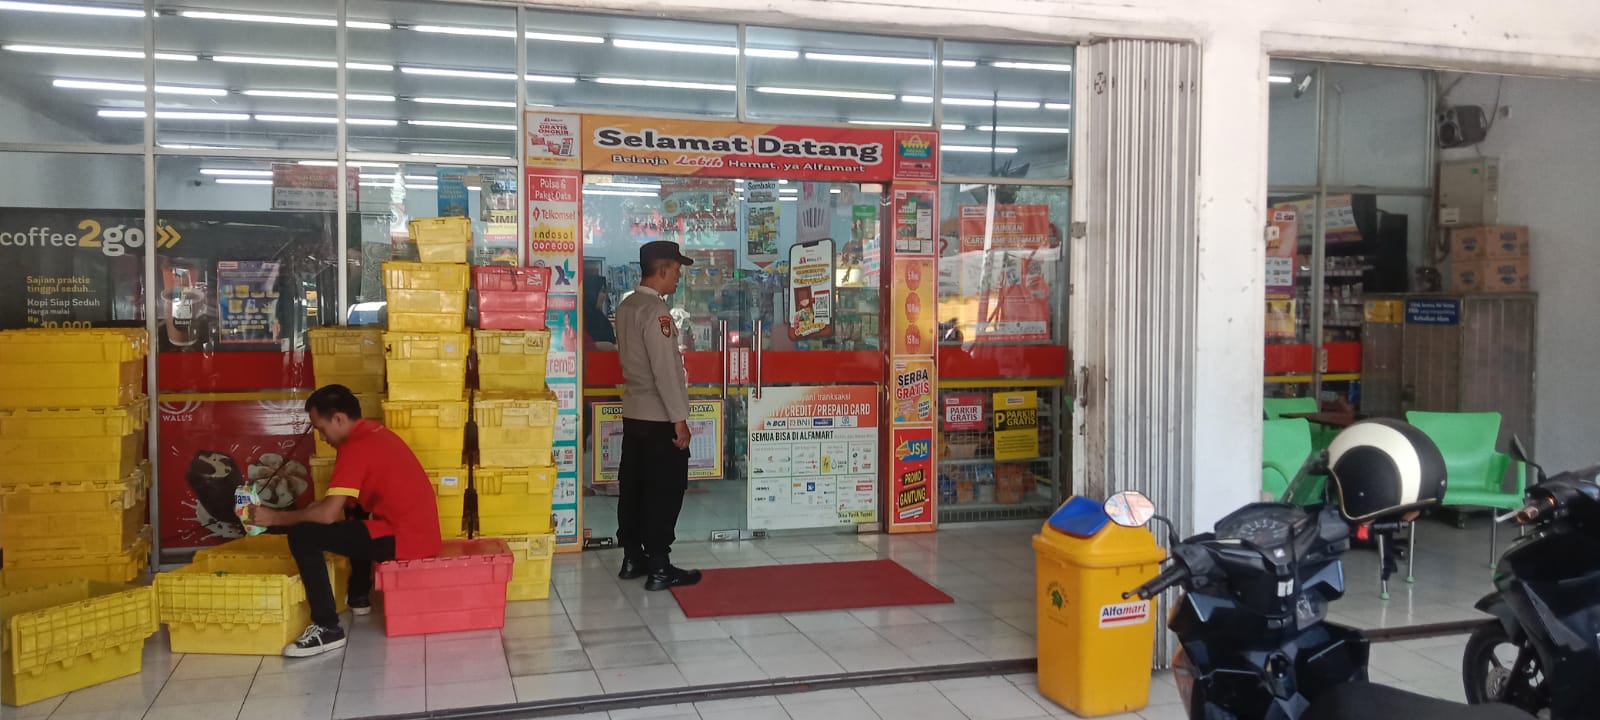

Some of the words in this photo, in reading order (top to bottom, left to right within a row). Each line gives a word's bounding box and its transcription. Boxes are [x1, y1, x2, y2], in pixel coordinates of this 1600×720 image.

[597, 129, 748, 153] Selamat
[757, 137, 878, 163] Datang
[612, 154, 669, 166] Belanja
[674, 154, 724, 168] Lebih
[728, 159, 780, 170] Hemat,
[783, 163, 799, 172] ya
[803, 162, 865, 173] Alfamart
[540, 178, 559, 189] Pulsa
[535, 190, 554, 200] Paket
[541, 209, 576, 220] Telkomsel
[0, 218, 145, 257] coffee2go
[533, 240, 575, 250] ooredoo
[26, 275, 55, 286] Sajian
[57, 275, 91, 286] praktis
[27, 284, 59, 295] tinggal
[27, 298, 48, 308] Kopi
[50, 298, 70, 308] Siap
[71, 298, 101, 307] Seduh
[27, 308, 49, 316] Harga
[898, 368, 929, 387] SERBA
[896, 382, 930, 400] GRATIS
[693, 404, 715, 413] DATA
[849, 402, 871, 416] CARD
[950, 406, 978, 415] PARKIR
[1006, 409, 1035, 419] PARKIR
[162, 414, 193, 422] WALL'S
[796, 418, 811, 427] BNI
[950, 414, 978, 422] GRATIS
[1006, 417, 1036, 426] GRATIS
[751, 431, 775, 442] SEMUA
[775, 431, 791, 441] BISA
[791, 431, 799, 441] DI
[799, 430, 834, 441] ALFAMART
[910, 442, 929, 456] JSM
[904, 470, 922, 485] PROMO
[899, 487, 926, 507] GANTUNG
[1102, 603, 1147, 617] Alfamart
